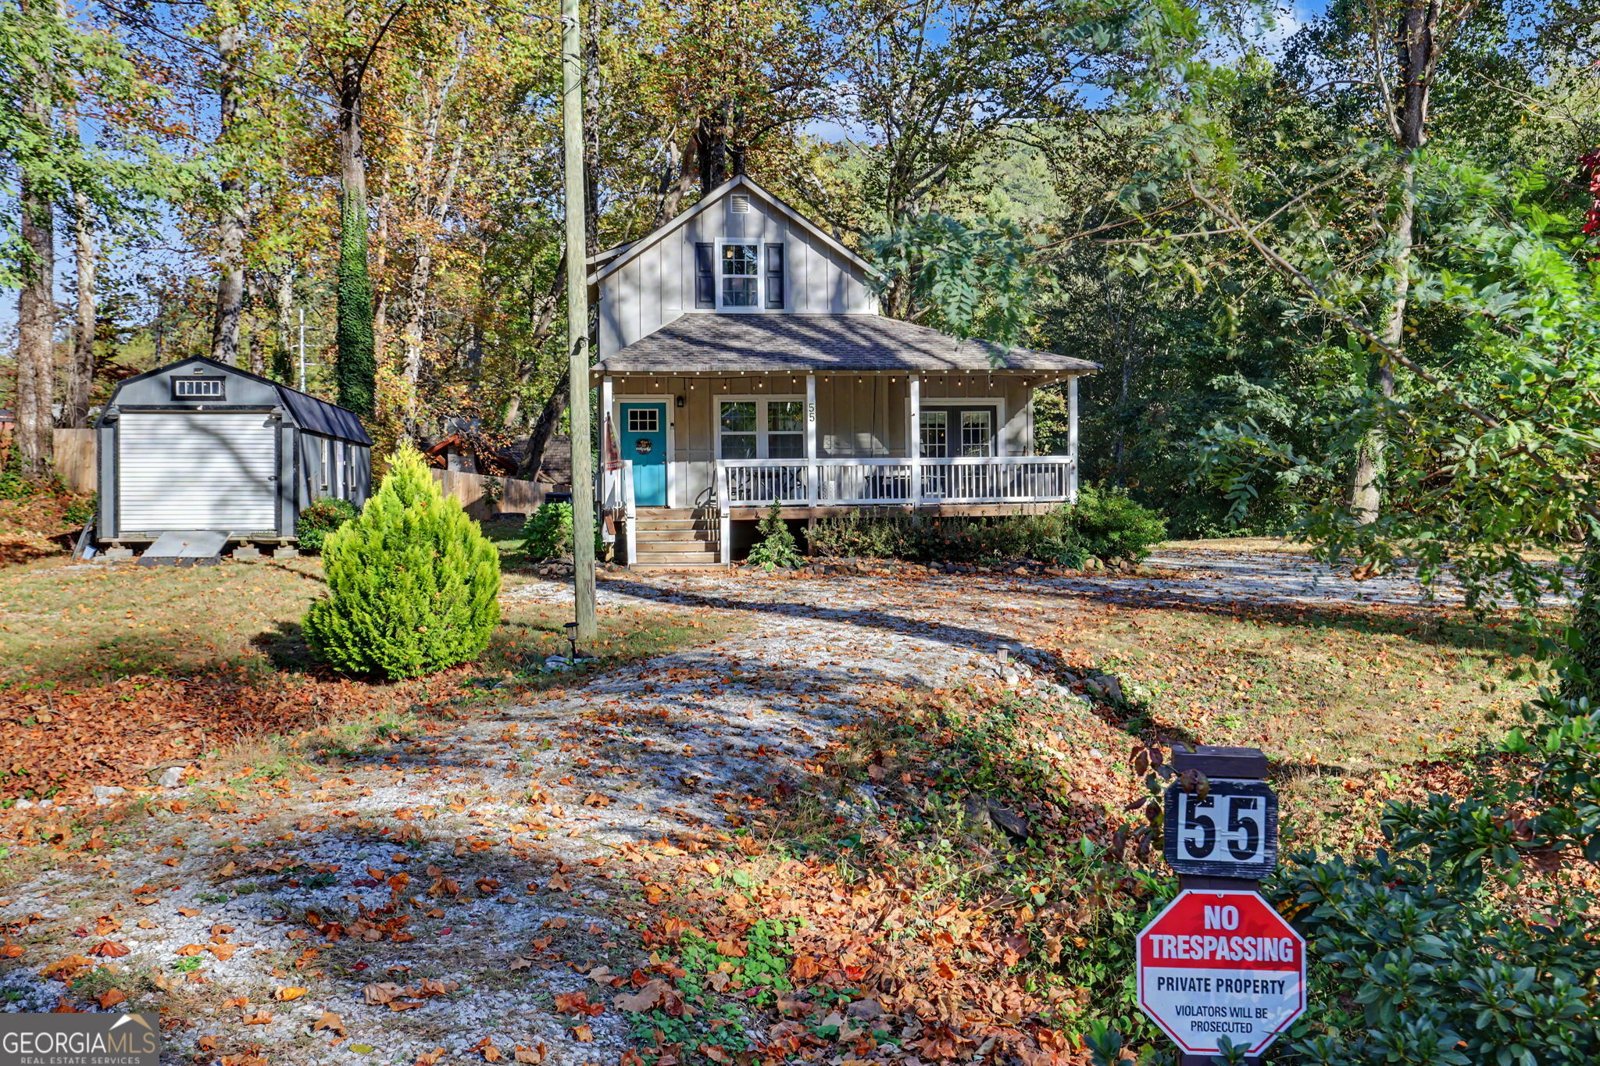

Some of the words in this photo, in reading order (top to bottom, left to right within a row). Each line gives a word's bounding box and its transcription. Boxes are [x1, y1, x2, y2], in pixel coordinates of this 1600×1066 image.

[808, 402, 815, 422] 55
[1184, 796, 1259, 860] 55
[1203, 905, 1239, 931] NO
[1149, 934, 1294, 963] TRESPASSING
[1157, 976, 1211, 992] PRIVATE
[1216, 978, 1285, 995] PROPERTY
[1175, 1005, 1227, 1018] VIOLATORS
[1229, 1006, 1252, 1019] WILL
[1255, 1007, 1268, 1019] BE
[1190, 1021, 1253, 1034] PROSECUTED
